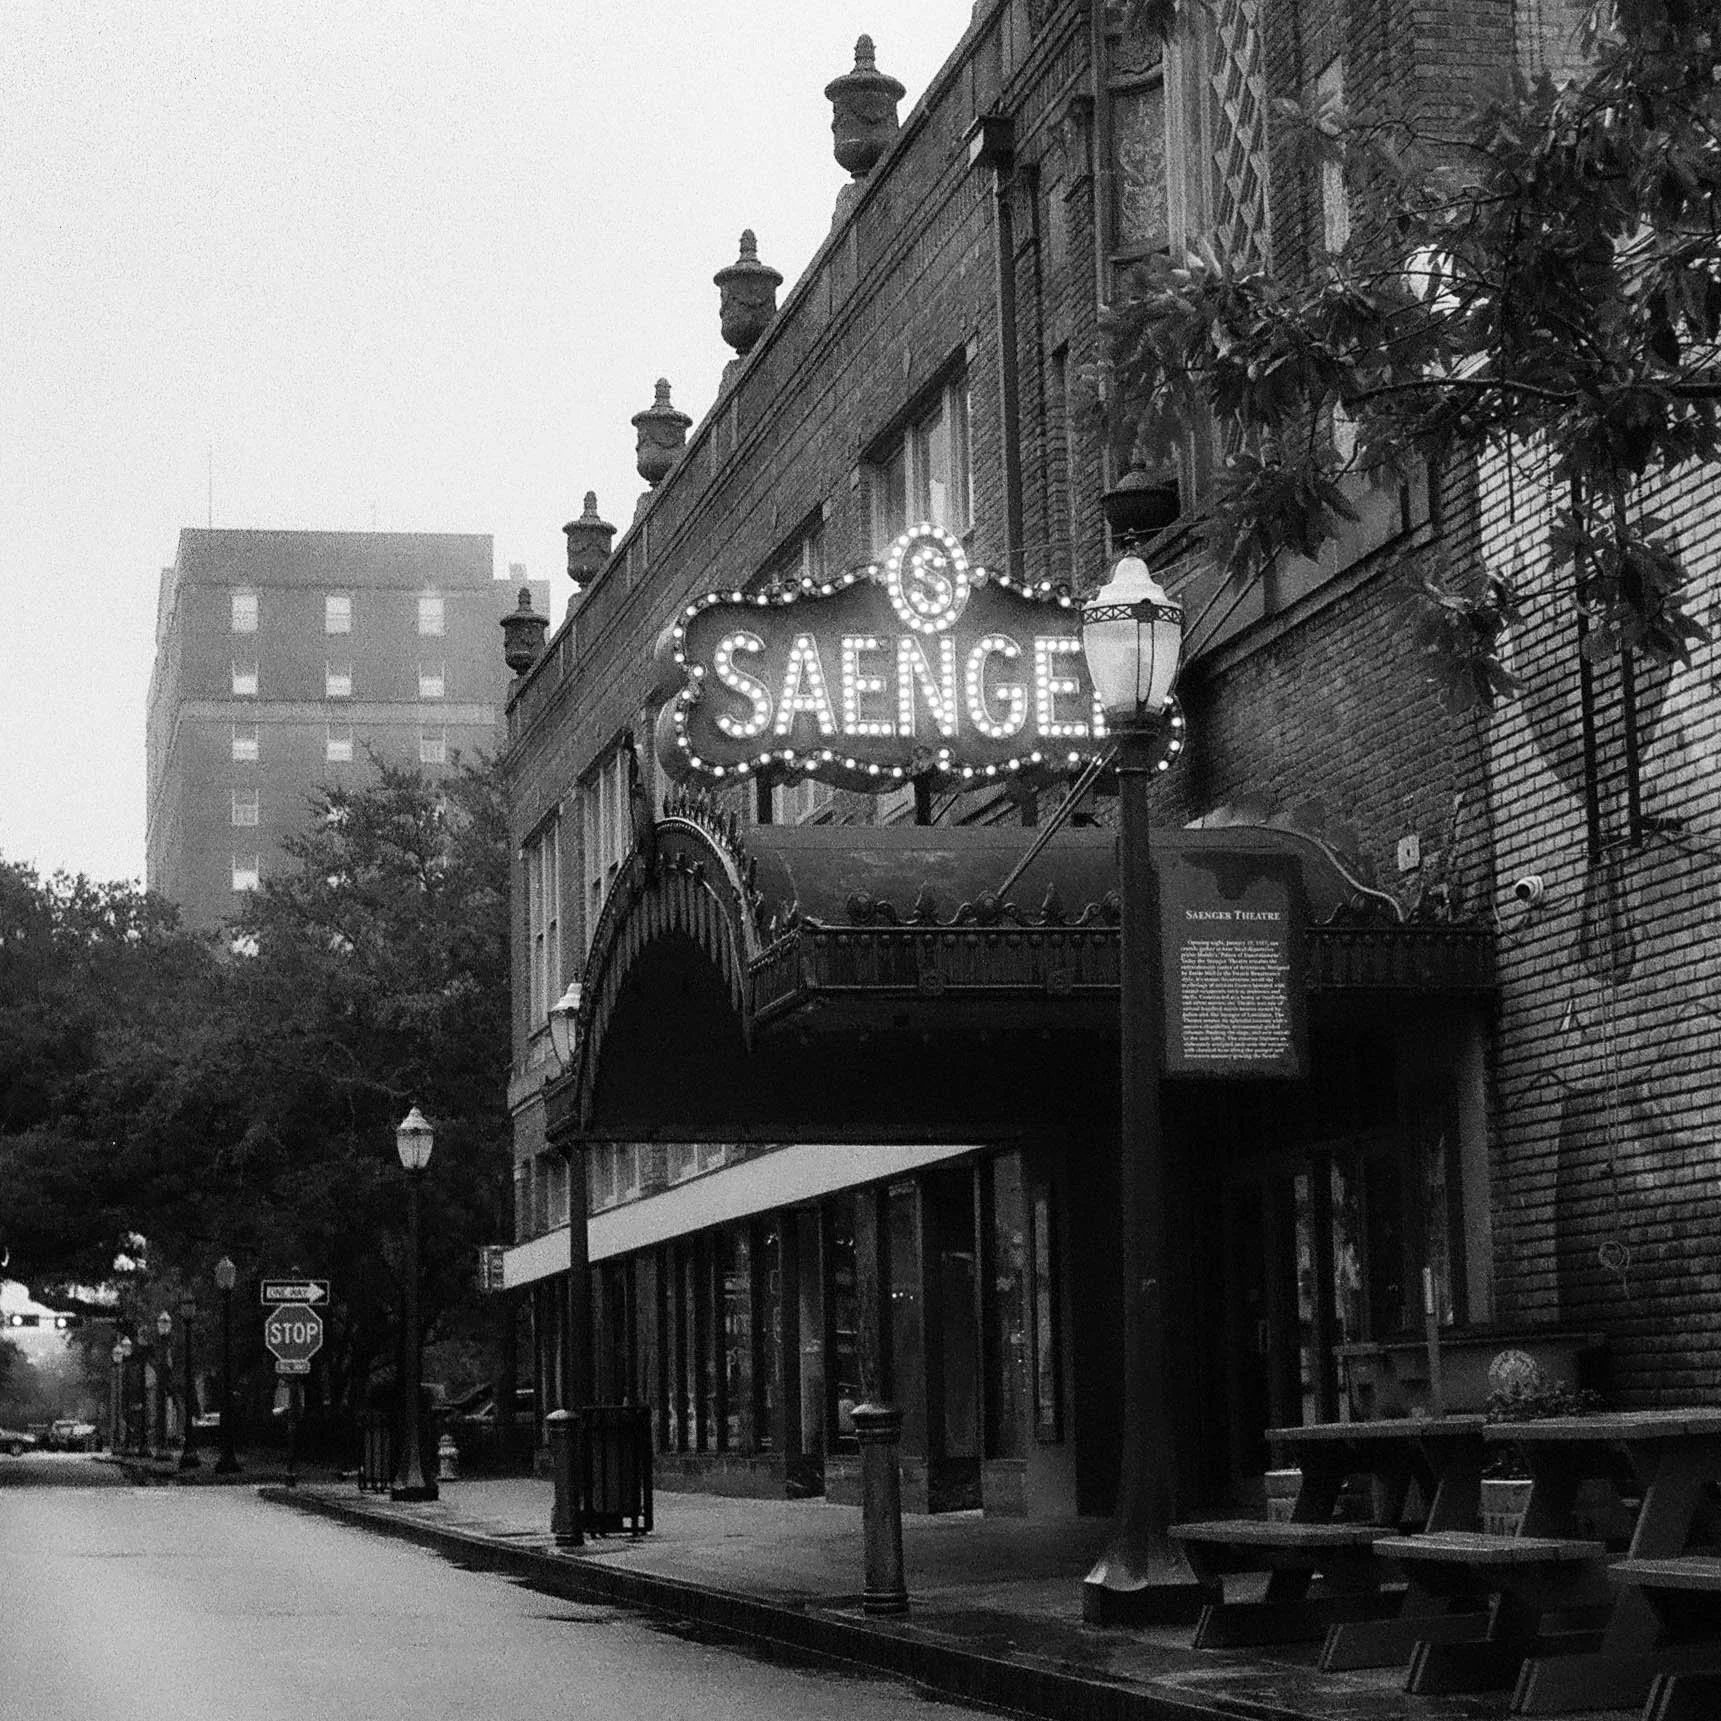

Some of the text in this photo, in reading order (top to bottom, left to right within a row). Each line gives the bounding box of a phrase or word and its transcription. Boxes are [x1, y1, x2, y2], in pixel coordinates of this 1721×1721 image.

[910, 545, 954, 617] S
[713, 631, 1105, 738] SAENGE
[1185, 910, 1281, 921] SAENGER THEATRE
[270, 1322, 318, 1344] STOP
